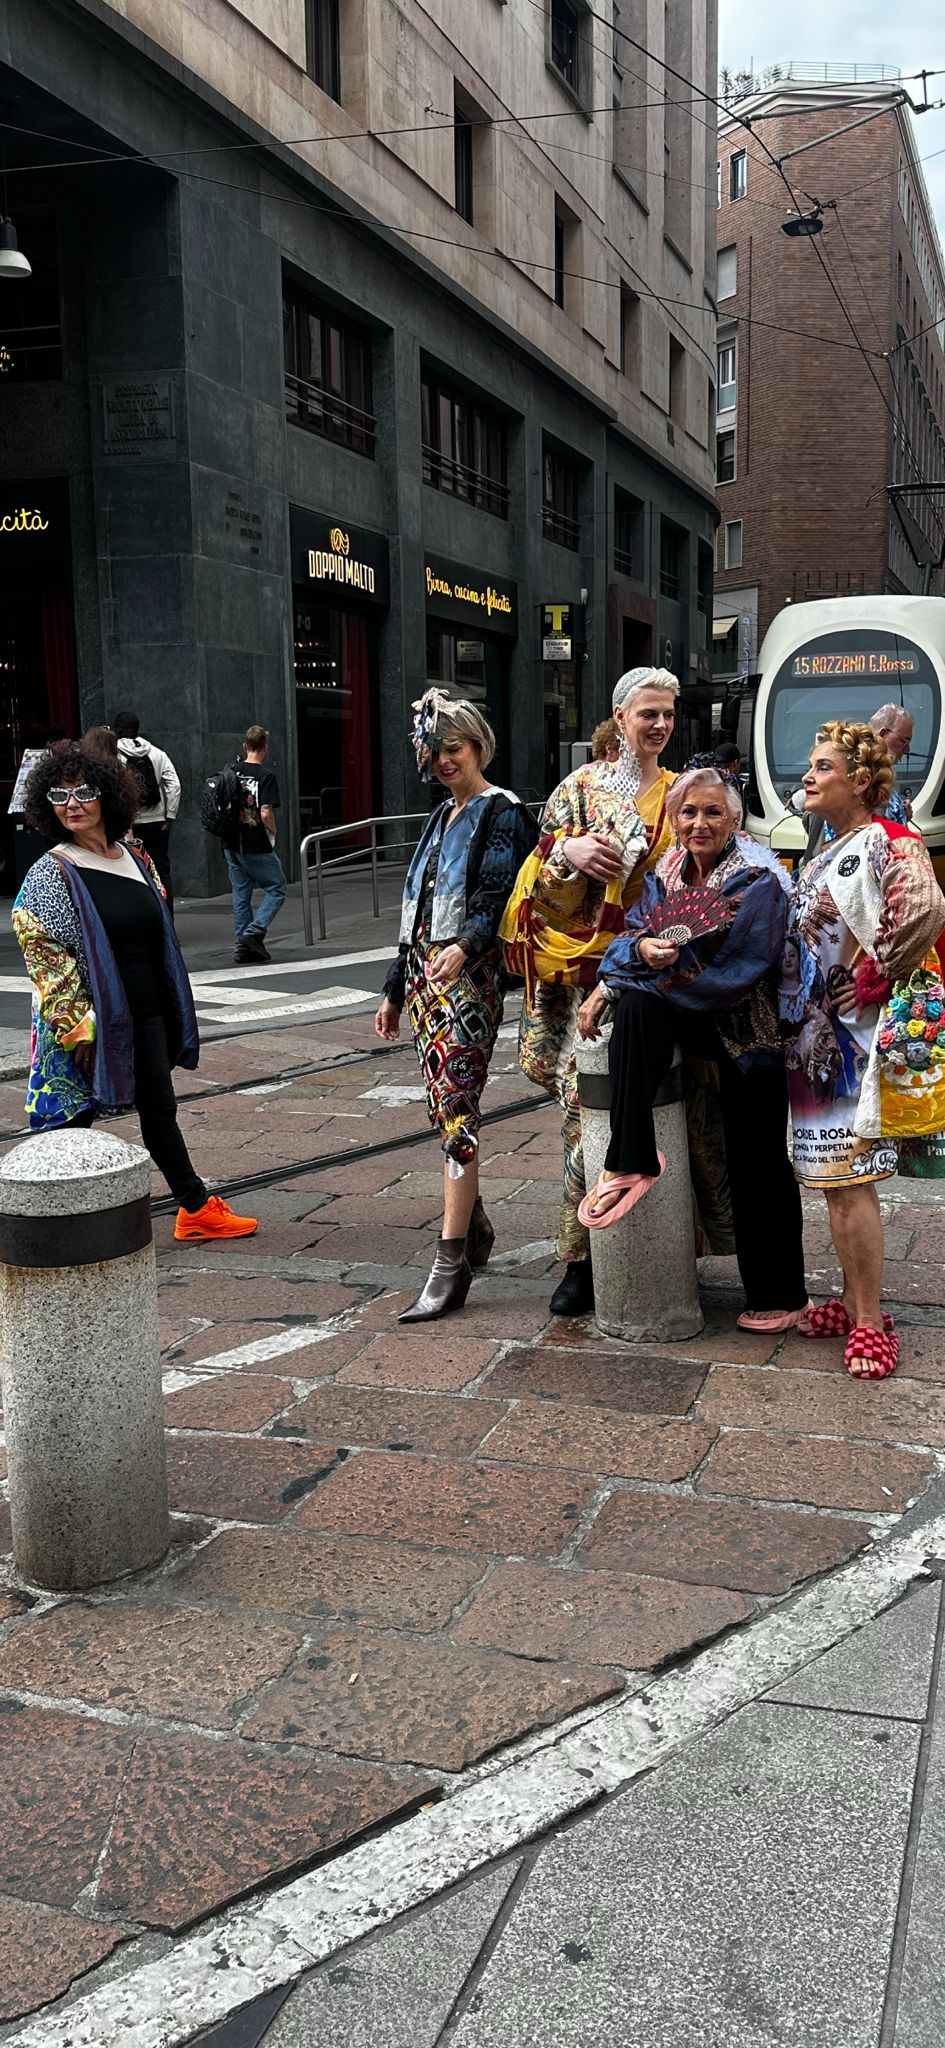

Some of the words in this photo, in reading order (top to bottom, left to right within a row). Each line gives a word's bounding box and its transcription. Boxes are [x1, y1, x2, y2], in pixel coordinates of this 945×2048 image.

[0, 508, 49, 531] cità
[308, 550, 344, 583] DOPPIO
[345, 558, 375, 593] MALTO
[426, 567, 453, 597] Birra,
[454, 583, 480, 604] cucina
[480, 592, 487, 606] e
[545, 605, 569, 630] T
[794, 657, 810, 675] 15
[812, 655, 866, 674] ROZZANO
[869, 654, 914, 673] G.Rossa
[820, 1128, 858, 1140] ROSA
[814, 1143, 854, 1152] PERPETUA
[818, 1156, 830, 1164] DEL
[831, 1154, 850, 1163] TEIDE
